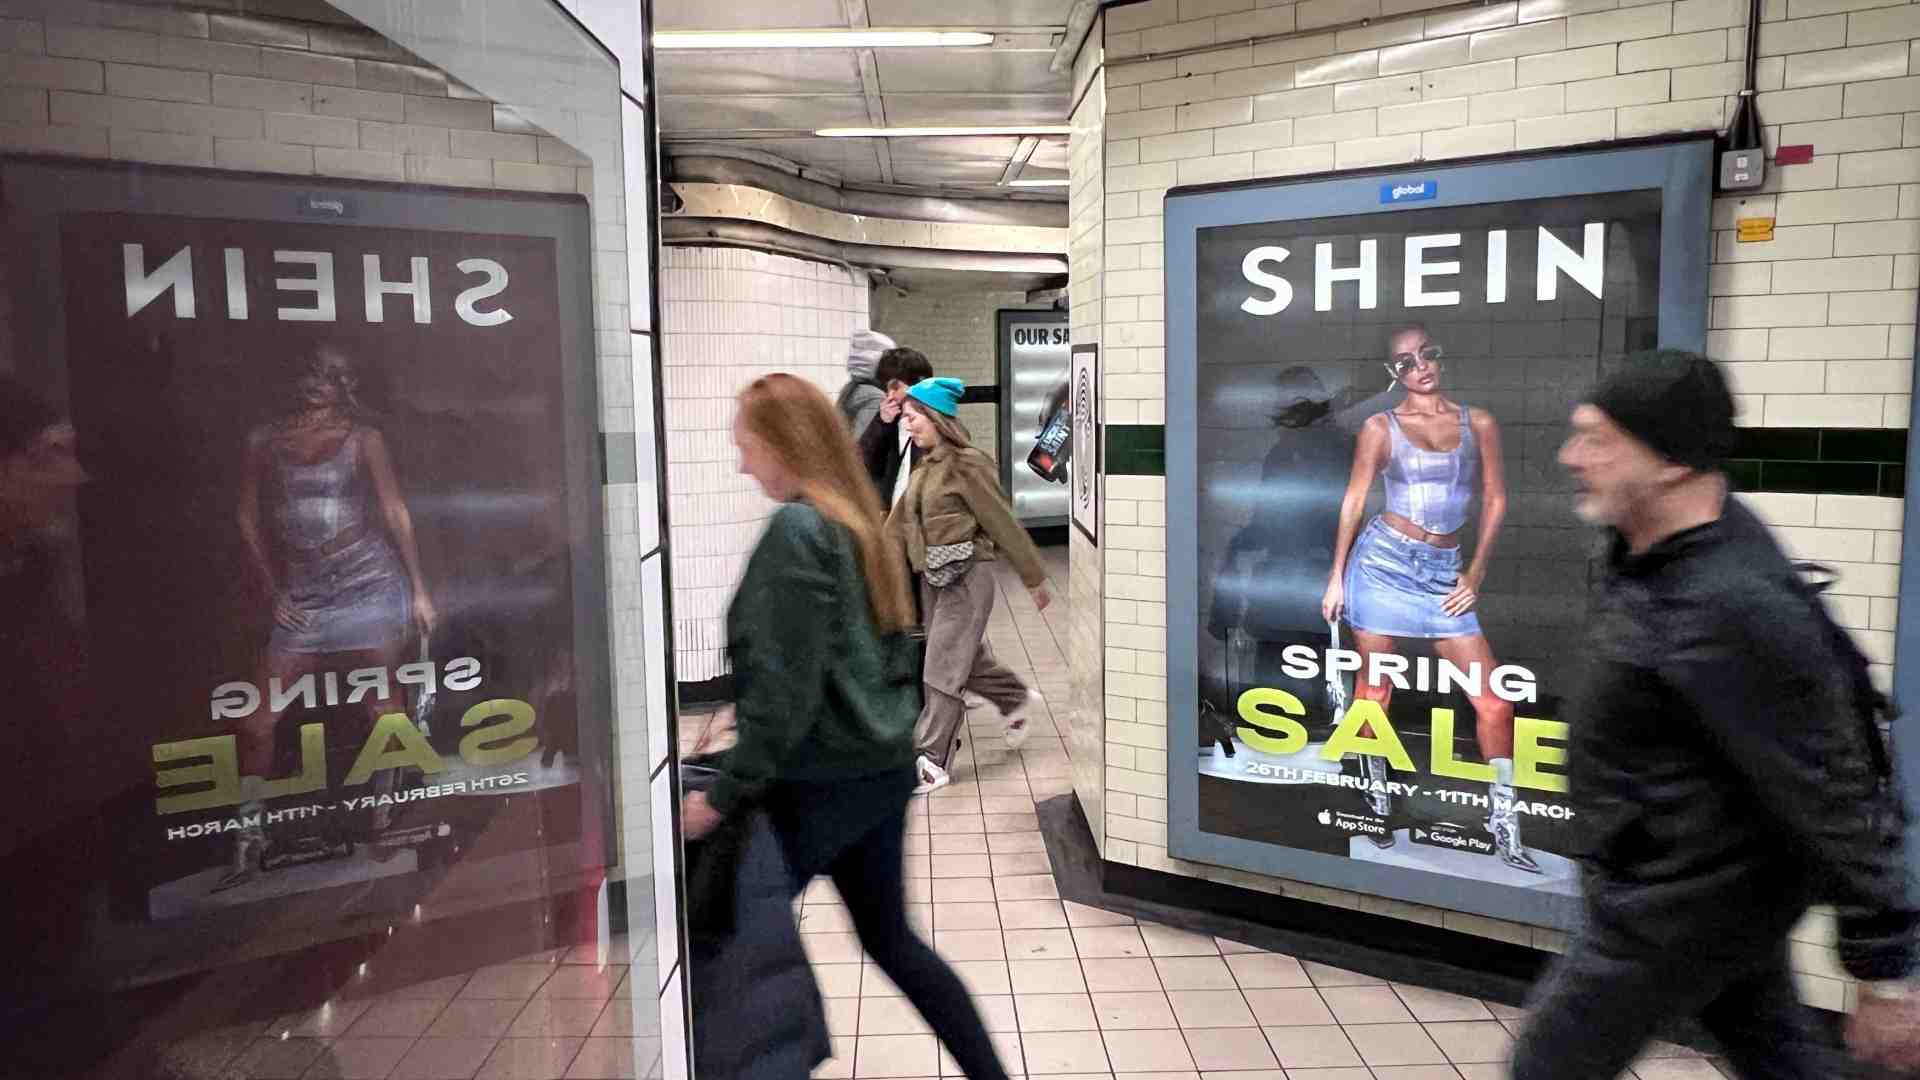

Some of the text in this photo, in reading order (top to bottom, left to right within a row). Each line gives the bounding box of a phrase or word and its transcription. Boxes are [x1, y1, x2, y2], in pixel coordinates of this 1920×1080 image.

[1392, 183, 1425, 200] global
[1240, 222, 1605, 316] SHEIN
[1014, 327, 1049, 345] OUR
[1280, 644, 1537, 703] SPRING
[1236, 687, 1571, 793] SALE
[1246, 761, 1297, 780] 26TH
[1301, 769, 1419, 797] FEBRUARY
[1435, 789, 1489, 809] 11TH
[1335, 818, 1386, 834] App Store
[1430, 831, 1493, 852] Google Play
